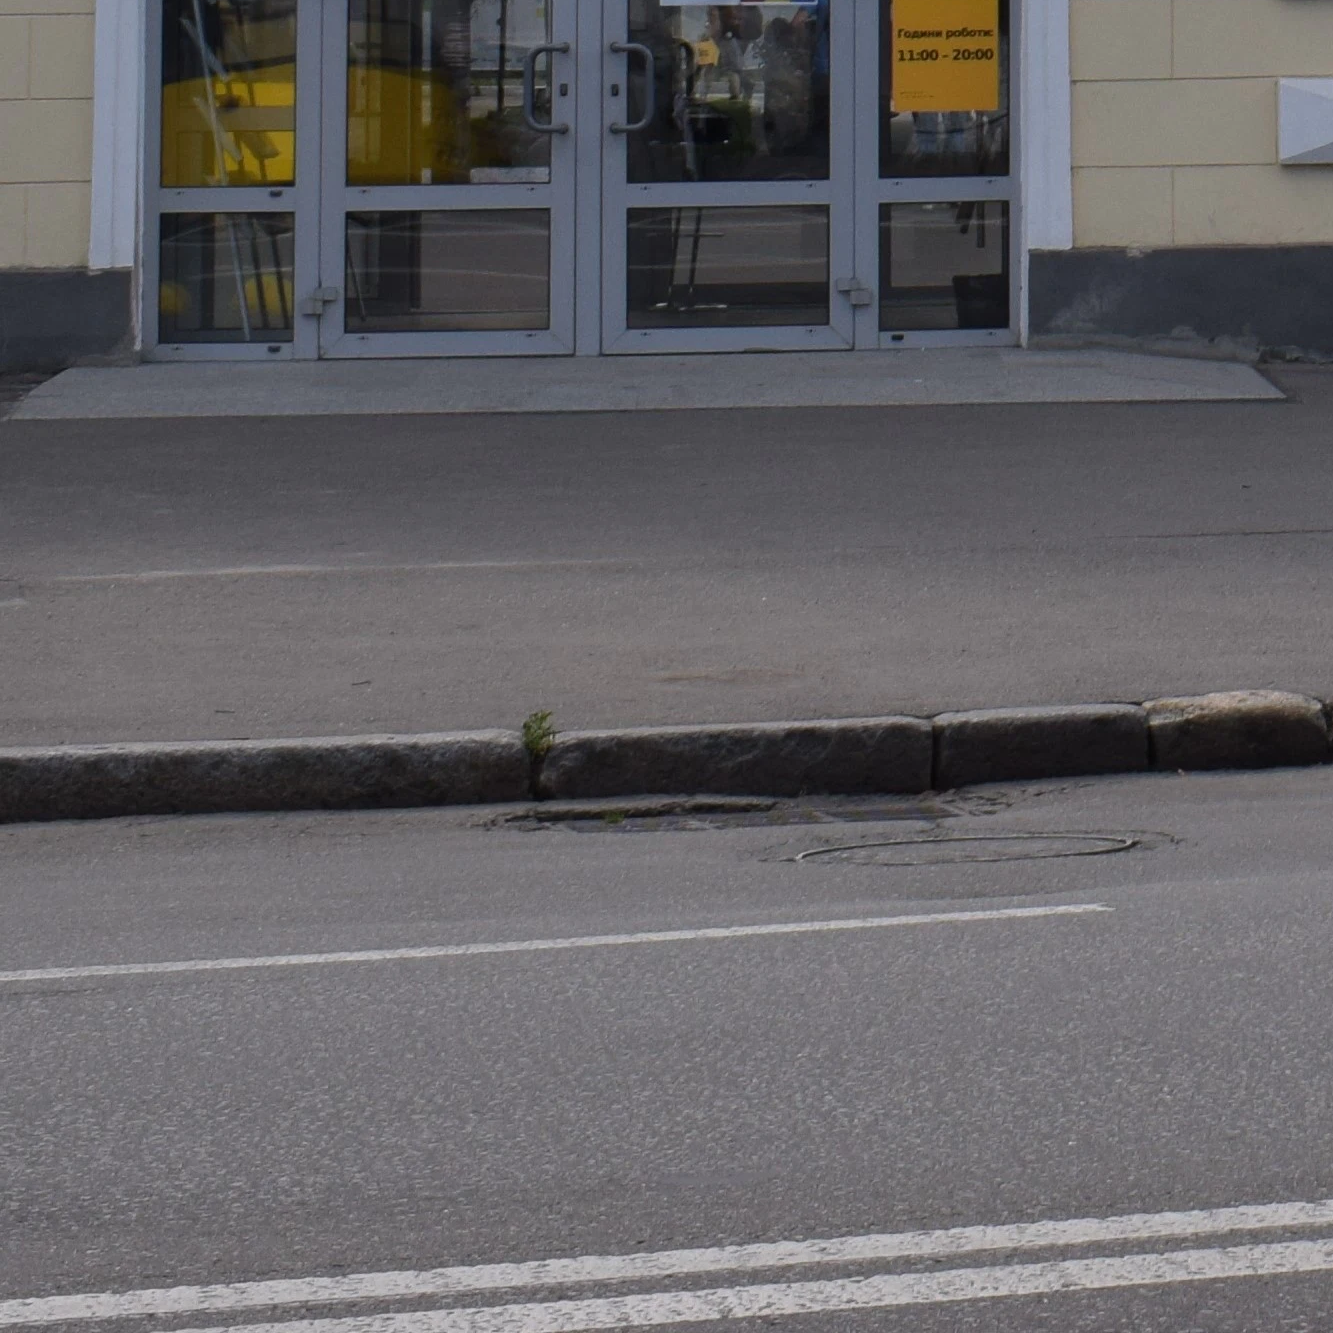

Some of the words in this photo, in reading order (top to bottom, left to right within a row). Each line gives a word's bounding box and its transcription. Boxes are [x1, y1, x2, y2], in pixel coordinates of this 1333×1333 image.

[897, 28, 943, 40] Години
[898, 49, 940, 62] 11:00
[952, 48, 995, 61] 20:00
